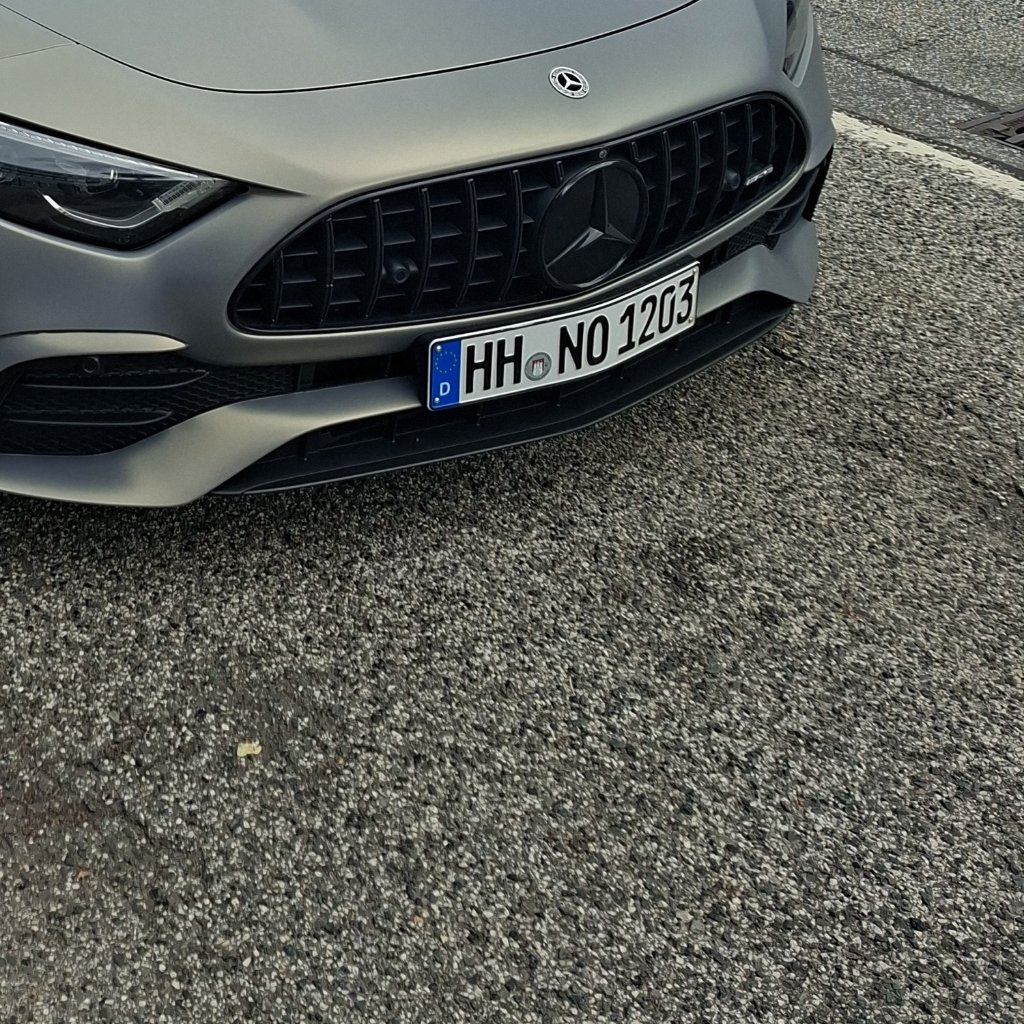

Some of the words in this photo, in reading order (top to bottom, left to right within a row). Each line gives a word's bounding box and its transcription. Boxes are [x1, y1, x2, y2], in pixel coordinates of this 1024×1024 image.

[465, 335, 524, 394] HH
[558, 314, 610, 374] NO
[618, 277, 696, 356] 1203
[439, 381, 451, 397] D
